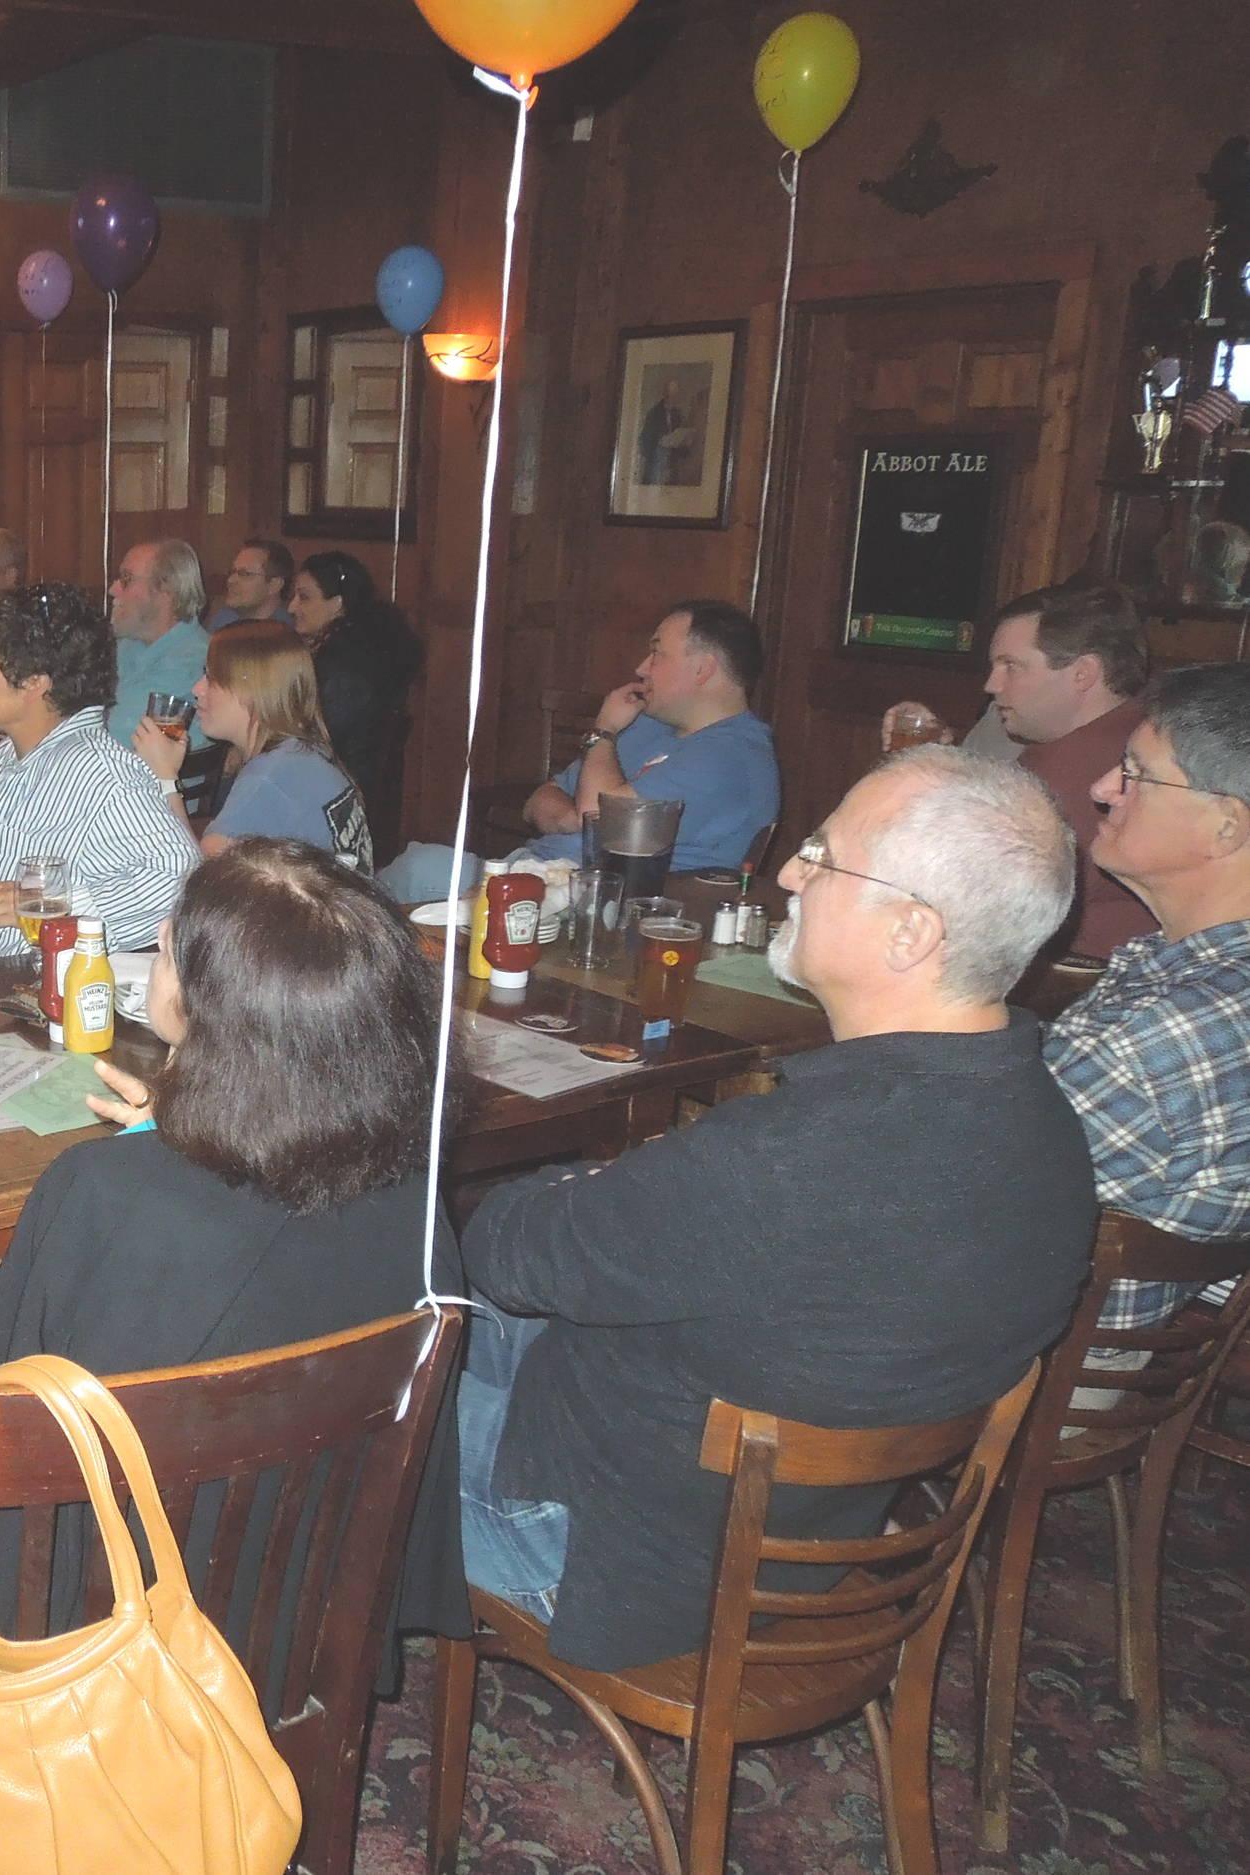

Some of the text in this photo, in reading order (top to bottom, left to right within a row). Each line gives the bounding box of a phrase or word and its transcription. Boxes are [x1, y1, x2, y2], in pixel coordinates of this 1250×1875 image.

[871, 452, 988, 472] ABBOT ALE
[86, 987, 105, 996] HEINZ
